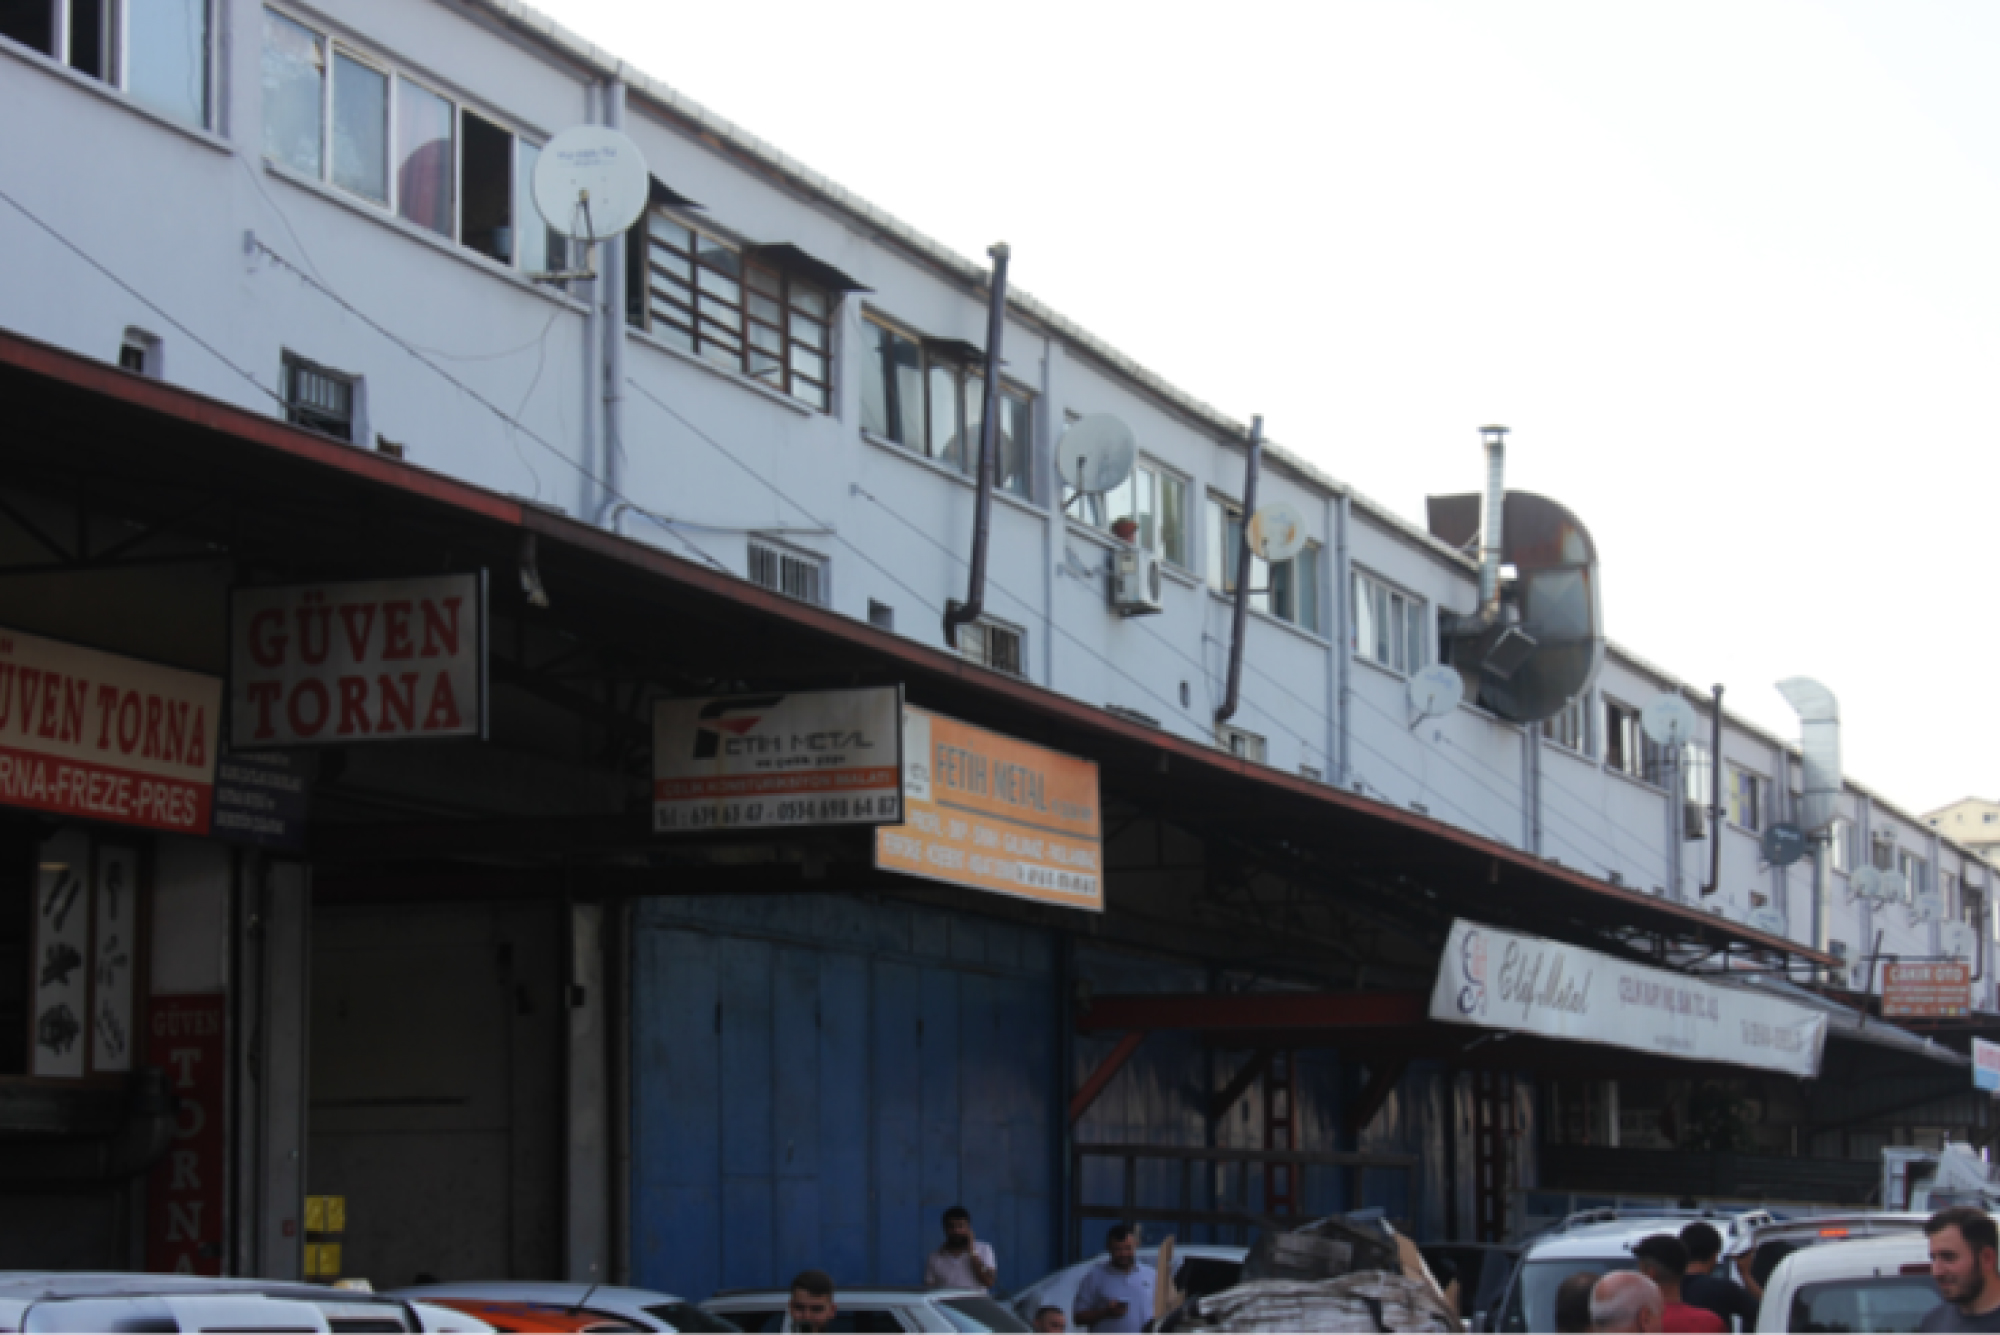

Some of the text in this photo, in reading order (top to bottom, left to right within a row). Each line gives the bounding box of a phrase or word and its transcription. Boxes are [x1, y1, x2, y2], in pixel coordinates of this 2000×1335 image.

[248, 592, 462, 667] GÜVEN
[97, 684, 207, 768] TORNA
[247, 670, 462, 740] TORNA
[790, 731, 875, 752] METAL
[935, 738, 988, 797] FETİH
[993, 759, 1048, 814] METAL
[152, 1003, 219, 1038] GÜVEN
